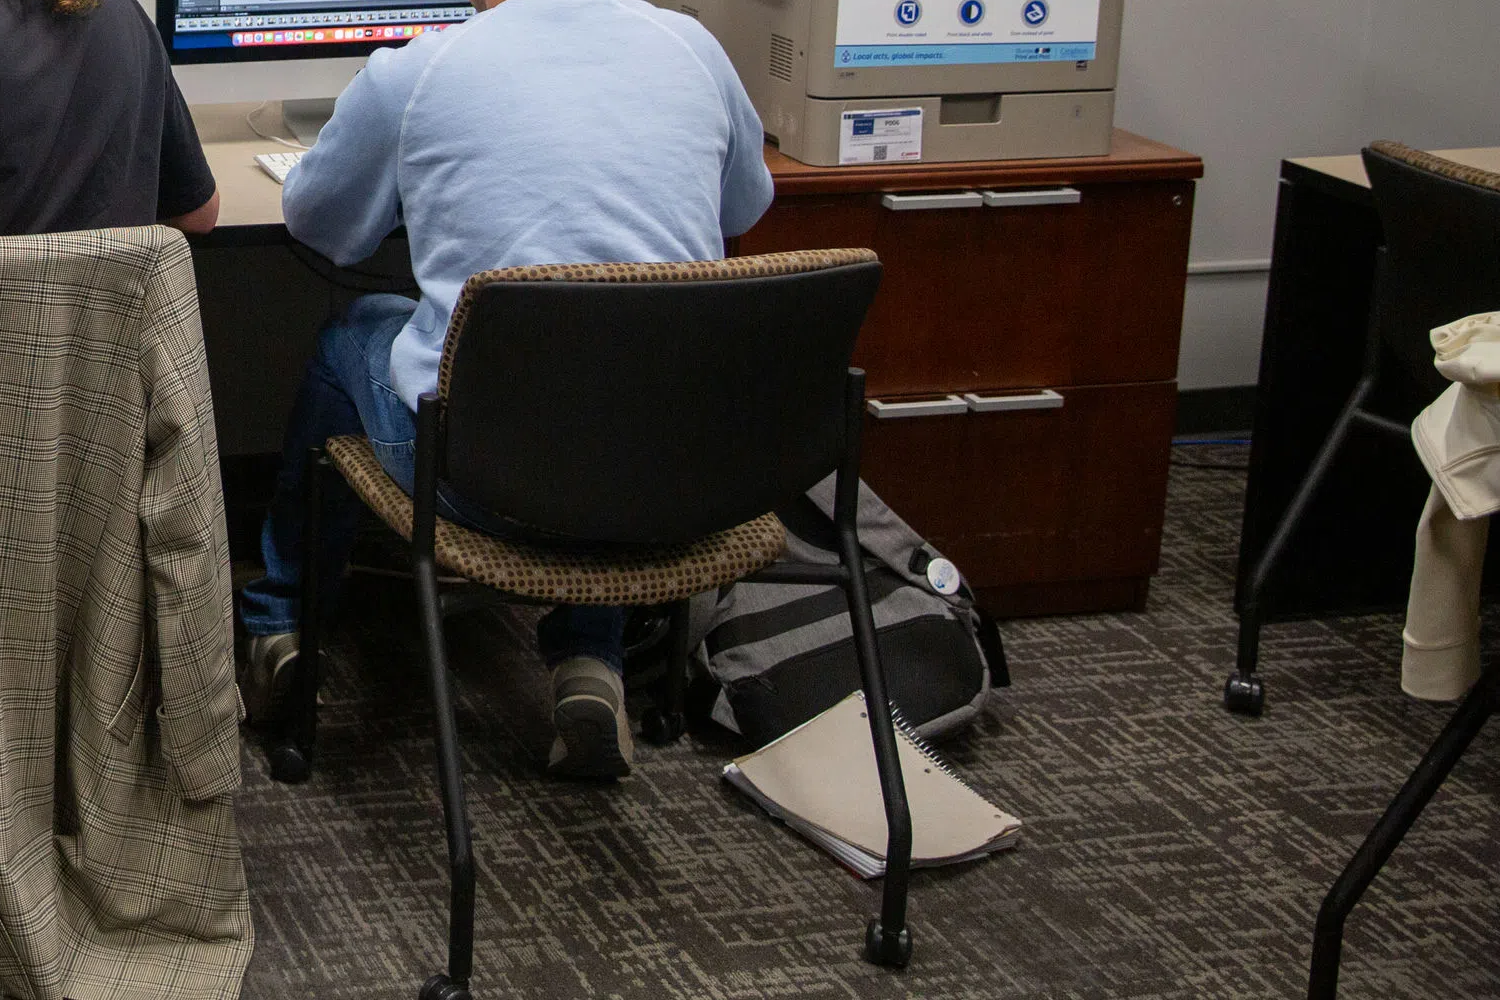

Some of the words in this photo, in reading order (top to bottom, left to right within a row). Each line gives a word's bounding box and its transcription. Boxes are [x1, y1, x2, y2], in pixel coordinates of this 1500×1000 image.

[853, 52, 872, 60] Local
[873, 52, 890, 61] acts,
[891, 52, 915, 61] global
